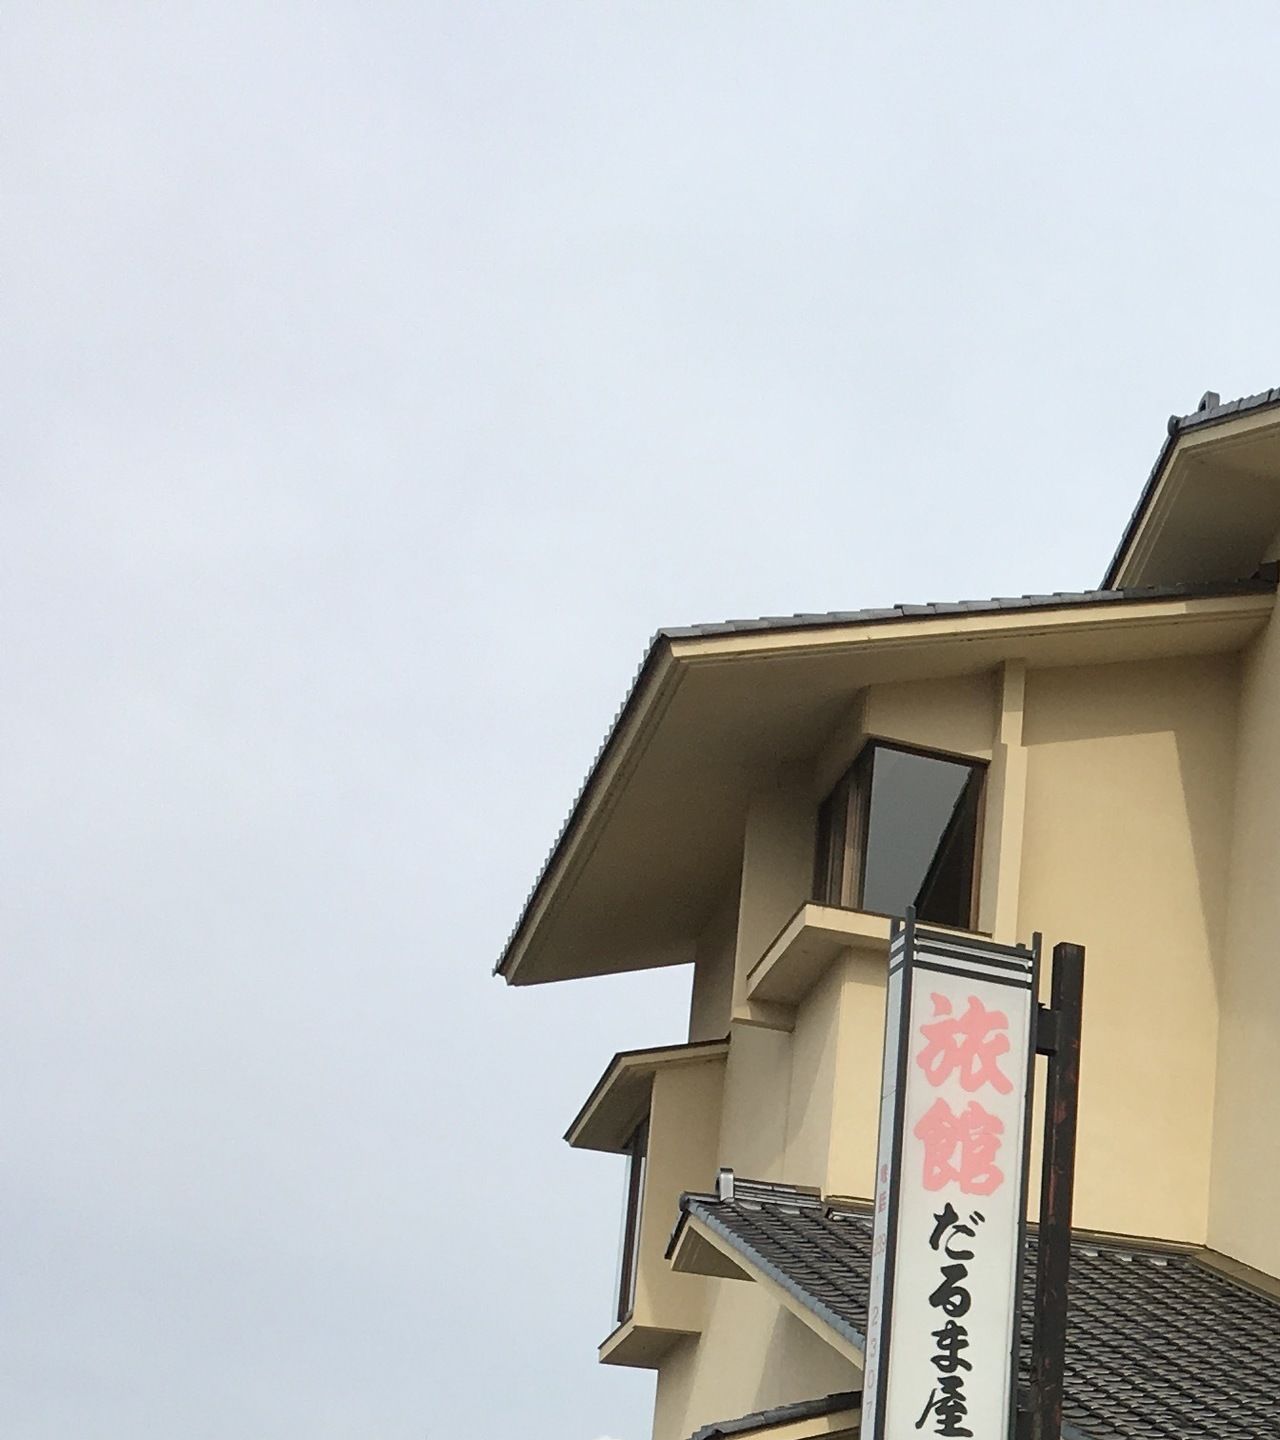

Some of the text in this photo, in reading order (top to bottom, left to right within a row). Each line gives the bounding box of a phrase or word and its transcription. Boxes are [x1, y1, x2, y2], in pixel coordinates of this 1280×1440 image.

[915, 992, 1014, 1197] 旅館
[915, 1202, 987, 1438] だるま屋
